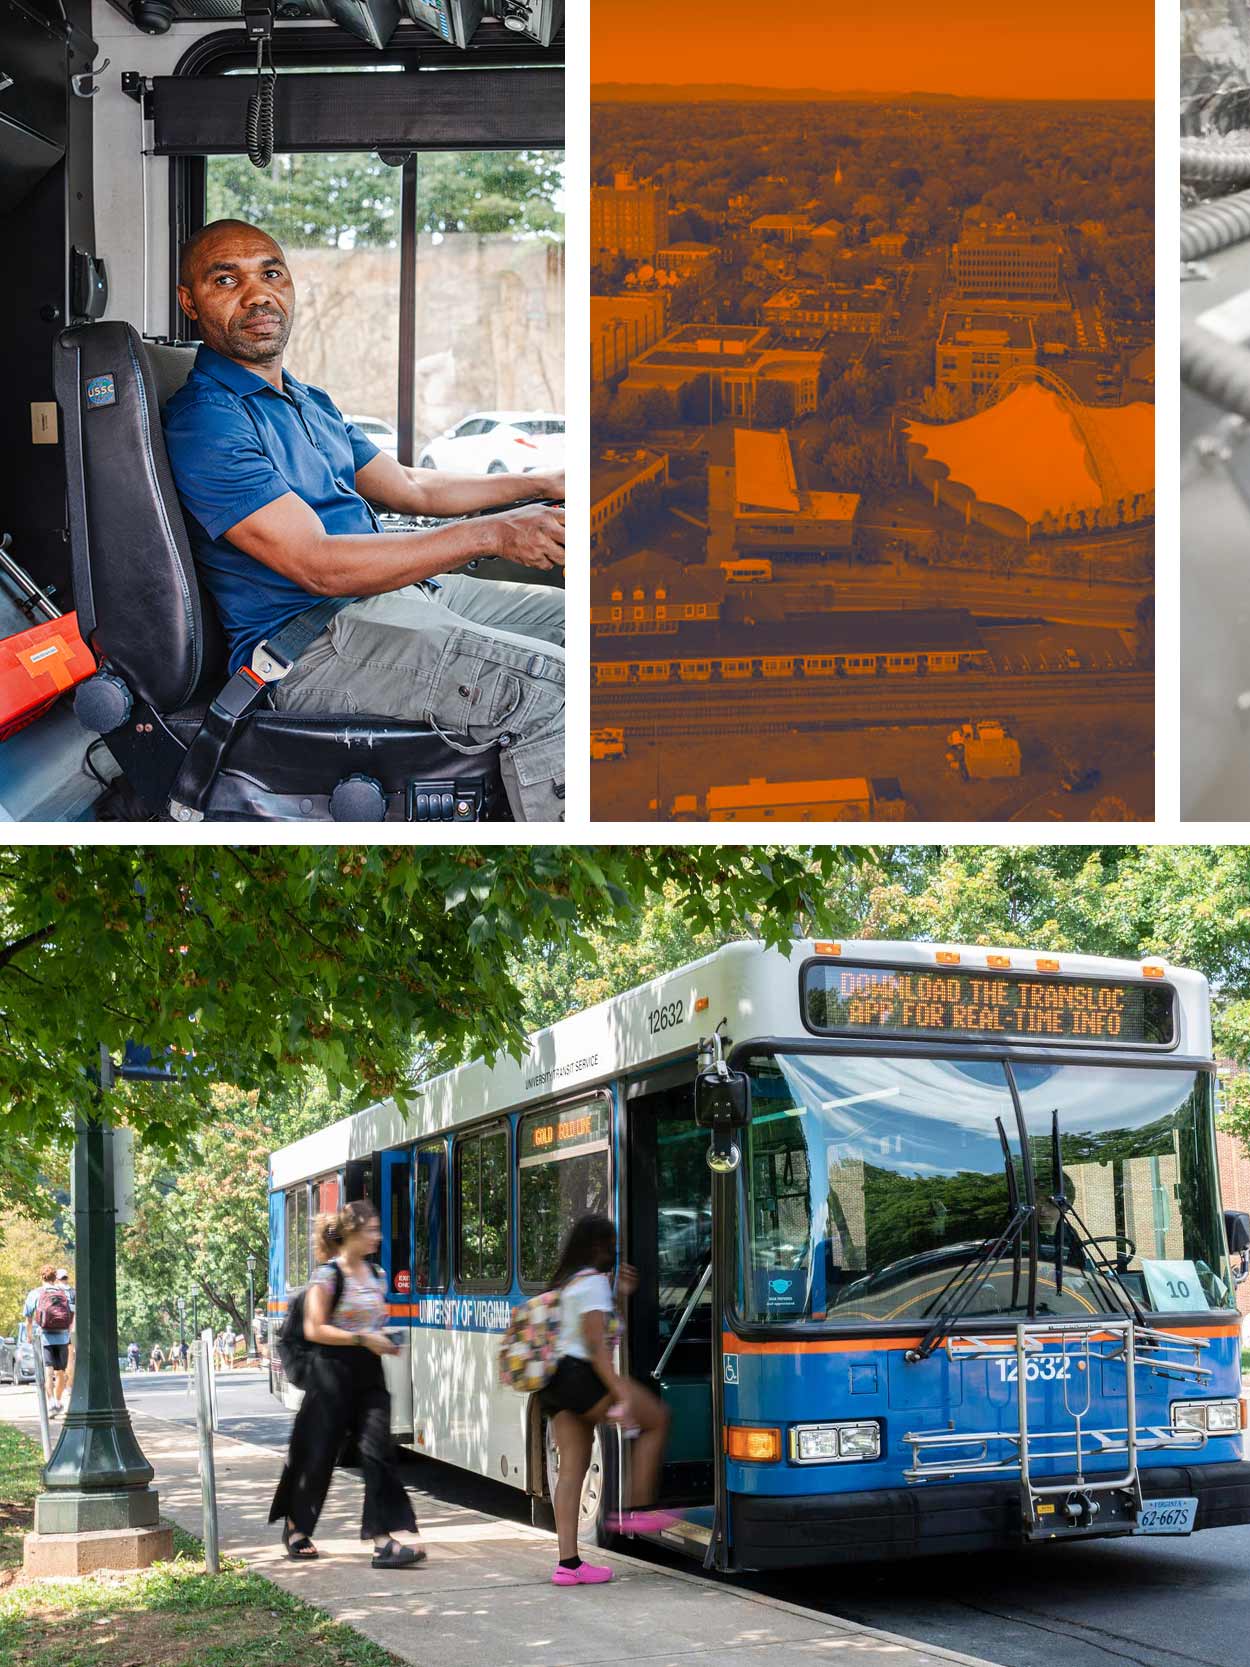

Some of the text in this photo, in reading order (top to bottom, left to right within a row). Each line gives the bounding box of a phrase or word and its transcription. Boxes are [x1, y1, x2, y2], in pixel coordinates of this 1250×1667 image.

[88, 383, 115, 398] USSC
[840, 972, 1126, 1011] DOWNLOAD THE TRANSLOC
[648, 999, 684, 1035] 12632
[849, 1000, 1122, 1036] APP FOR REAL-TIME INFO
[575, 1053, 599, 1073] SERVICE
[534, 1126, 554, 1146] GOLD
[1166, 1280, 1191, 1299] 10
[419, 1299, 511, 1329] UNIVERSITY OF VIRGINIA
[995, 1356, 1072, 1382] 12632
[1142, 1509, 1189, 1526] 62-667S
